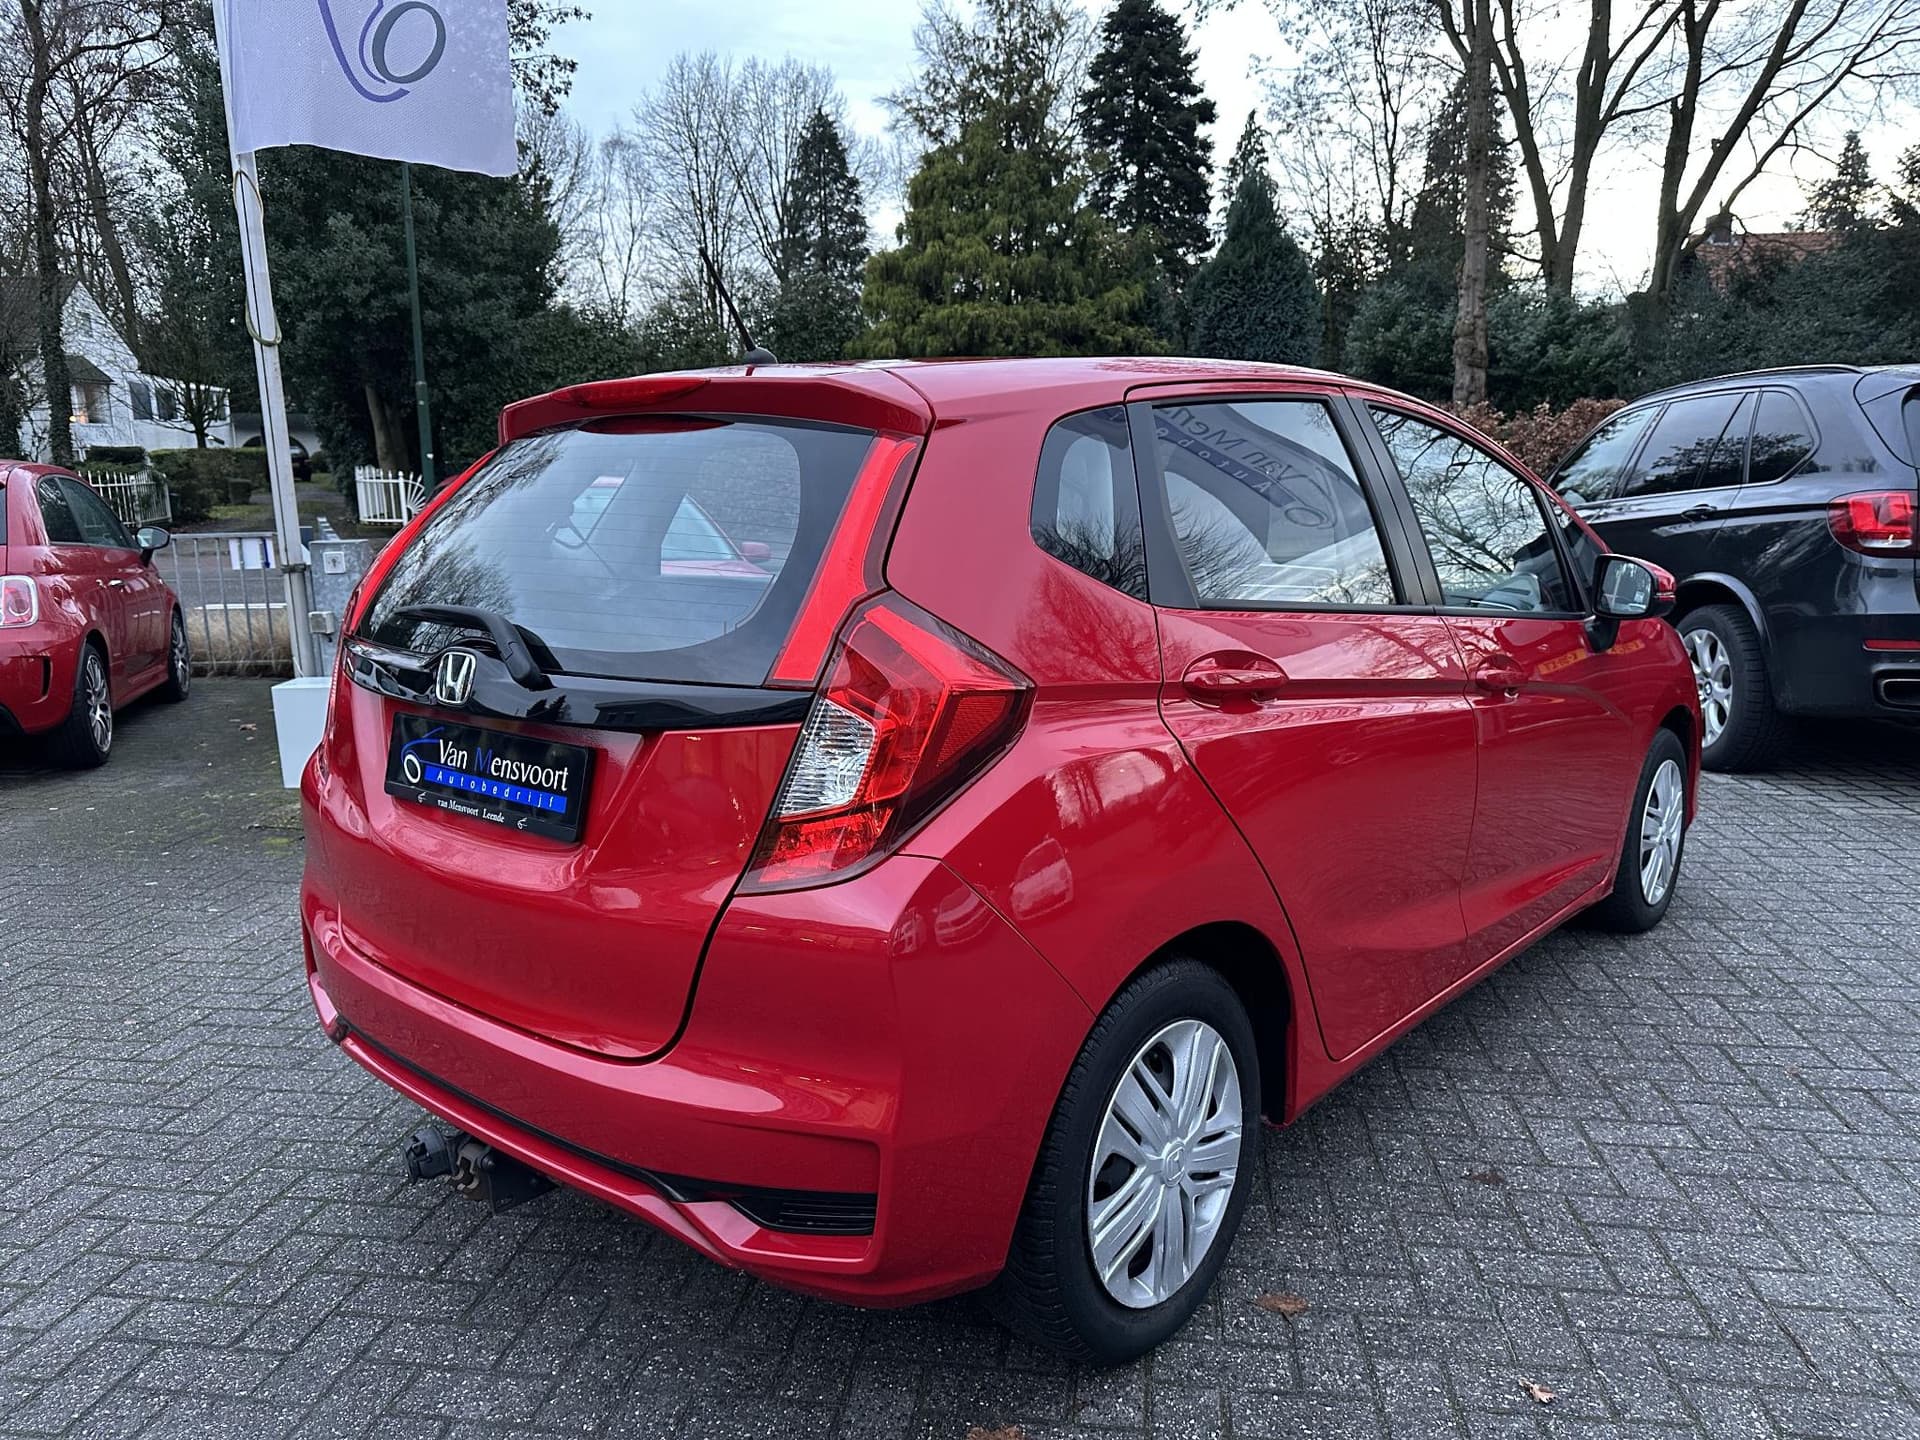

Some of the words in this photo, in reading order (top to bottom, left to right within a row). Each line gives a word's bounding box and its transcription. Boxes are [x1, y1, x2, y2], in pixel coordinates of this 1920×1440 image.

[439, 738, 468, 770] Van
[474, 746, 569, 792] Mensvoort
[436, 770, 554, 809] Autobedrijf
[448, 799, 479, 817] Mensvoort
[482, 808, 505, 823] Leende
